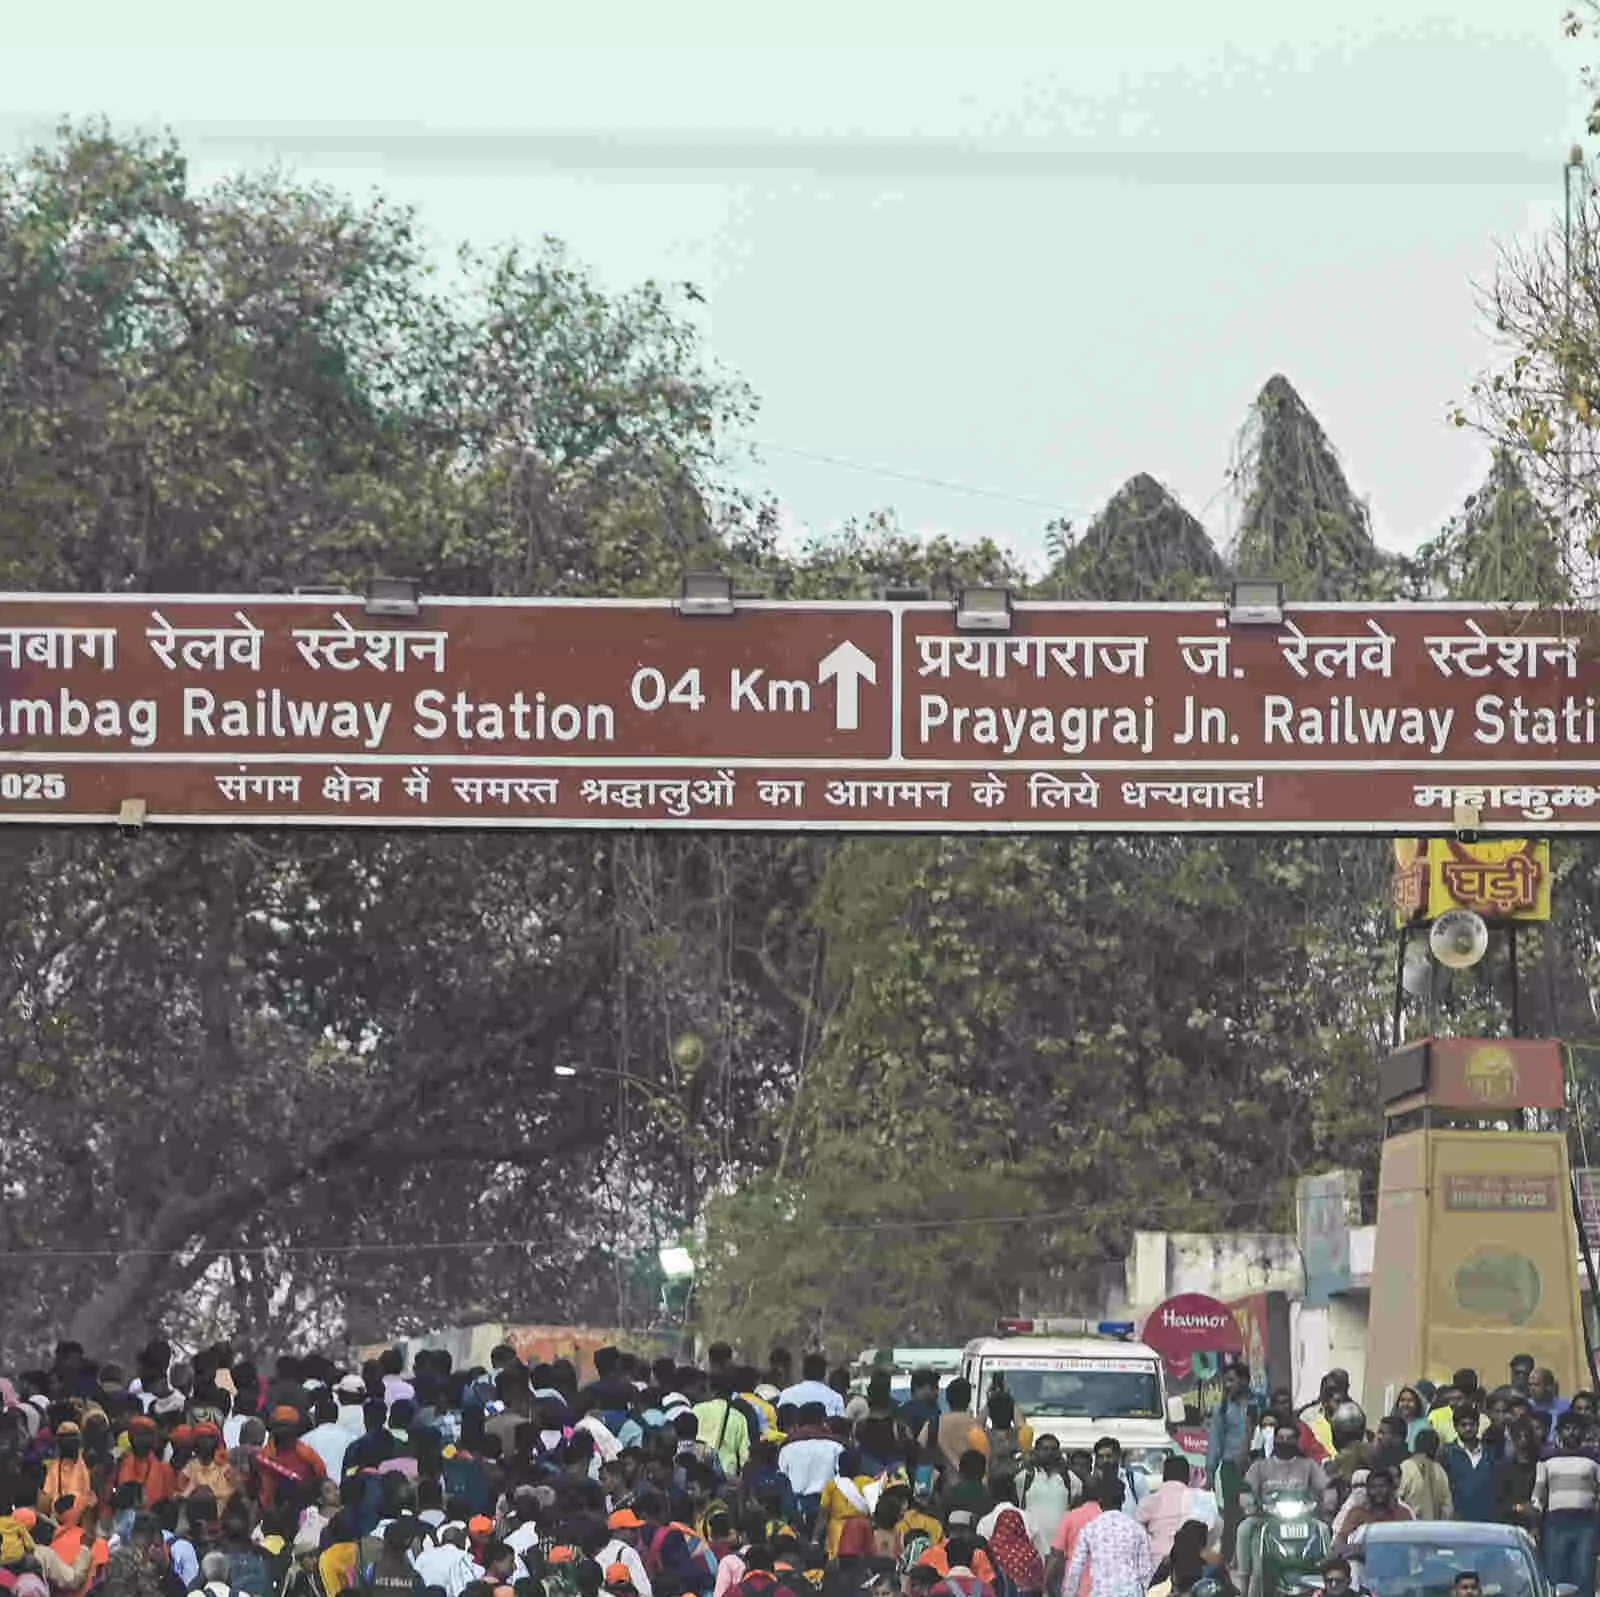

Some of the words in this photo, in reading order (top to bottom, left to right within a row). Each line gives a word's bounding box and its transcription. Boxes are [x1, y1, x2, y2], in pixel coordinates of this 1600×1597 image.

[146, 611, 264, 670] रेलवे
[292, 612, 448, 672] स्टेशन
[916, 636, 1148, 677] प्रयागराज
[1280, 620, 1395, 678] रेलवे
[1424, 619, 1578, 677] स्टेशन
[184, 688, 391, 747] Railway
[414, 690, 613, 740] Station
[631, 668, 705, 710] 04
[731, 669, 810, 711] Km
[921, 695, 1153, 753] Prayagraj
[1174, 696, 1239, 744] Jn.
[1265, 696, 1453, 753] Railway
[216, 767, 300, 801] संगम
[322, 767, 382, 803] क्षेत्र
[402, 768, 430, 803] में
[452, 778, 557, 803] समस्त
[579, 769, 736, 816] श्रद्धालुओं
[757, 781, 804, 806] का
[825, 781, 951, 807] आगमन
[971, 772, 1006, 807] के
[1027, 772, 1099, 808] लिये
[1121, 776, 1263, 808] धन्यवाद!
[1161, 1308, 1228, 1328] Havmor
